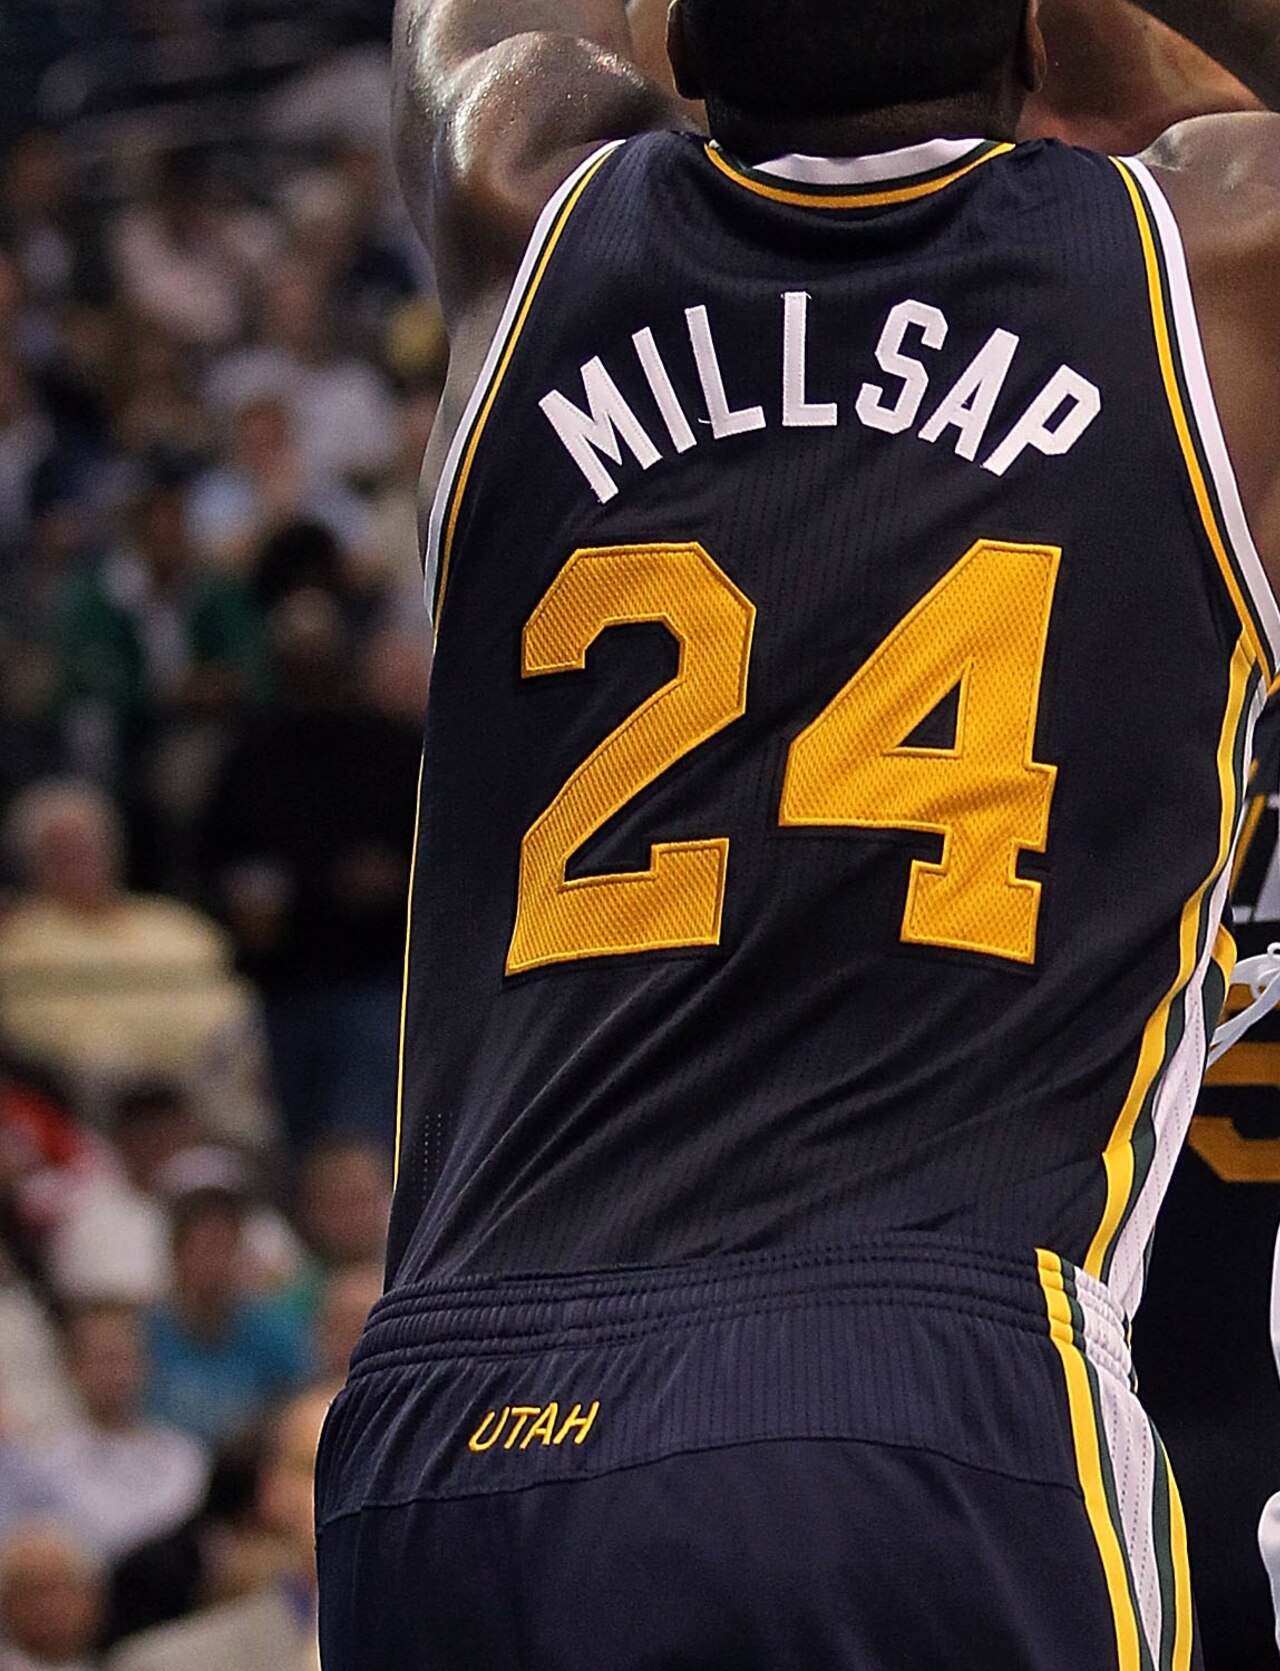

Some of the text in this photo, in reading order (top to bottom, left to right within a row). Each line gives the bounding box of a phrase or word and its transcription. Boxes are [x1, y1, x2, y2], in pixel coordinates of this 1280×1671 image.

[538, 291, 1101, 504] MILLSAP
[504, 538, 1062, 976] 24
[468, 1400, 600, 1452] UTAH
